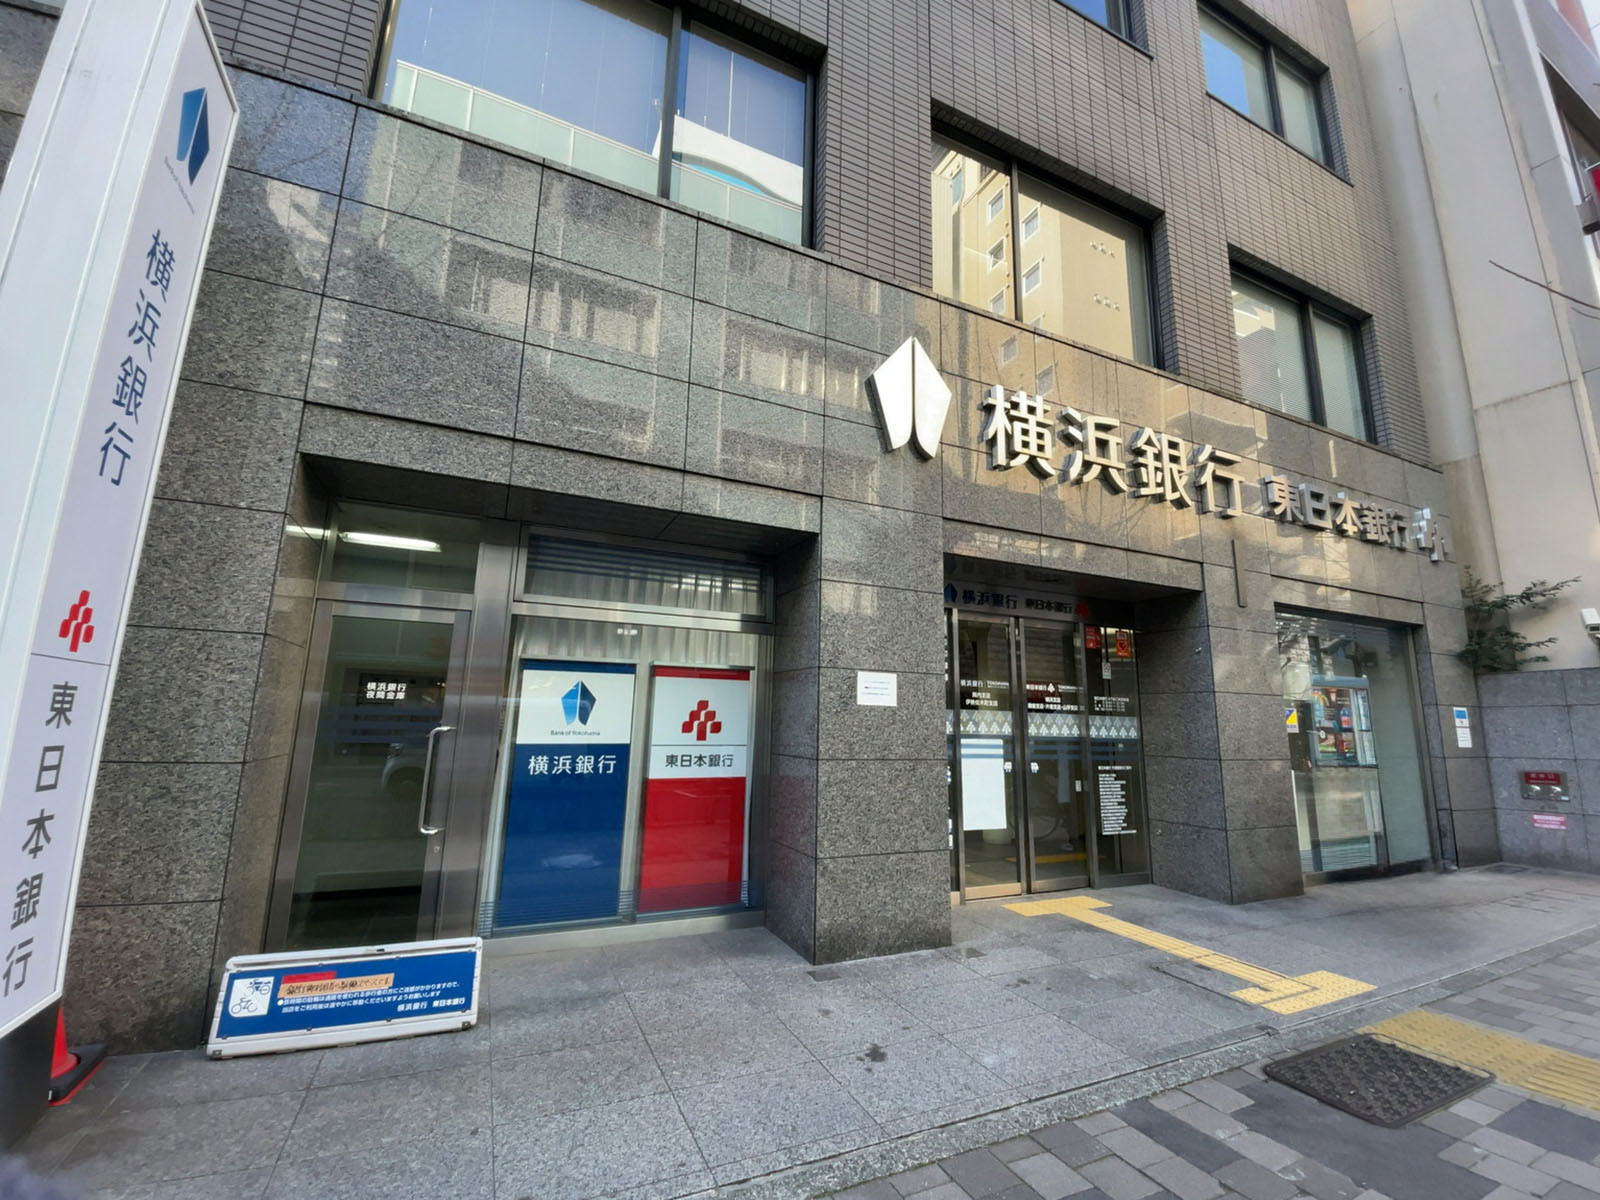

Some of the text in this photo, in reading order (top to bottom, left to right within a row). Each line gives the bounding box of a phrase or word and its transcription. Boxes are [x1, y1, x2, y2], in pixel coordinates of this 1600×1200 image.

[99, 229, 176, 487] 横浜銀行
[982, 384, 1408, 551] 横浜銀行 東日本銀行
[962, 589, 1017, 609] 横浜銀行
[367, 682, 406, 691] 横浜銀行
[528, 755, 616, 776] 横浜銀行
[665, 754, 734, 768] 東日本銀行
[2, 681, 79, 997] 東日本銀行
[397, 997, 466, 1012] 横浜銀行 東日本銀行
